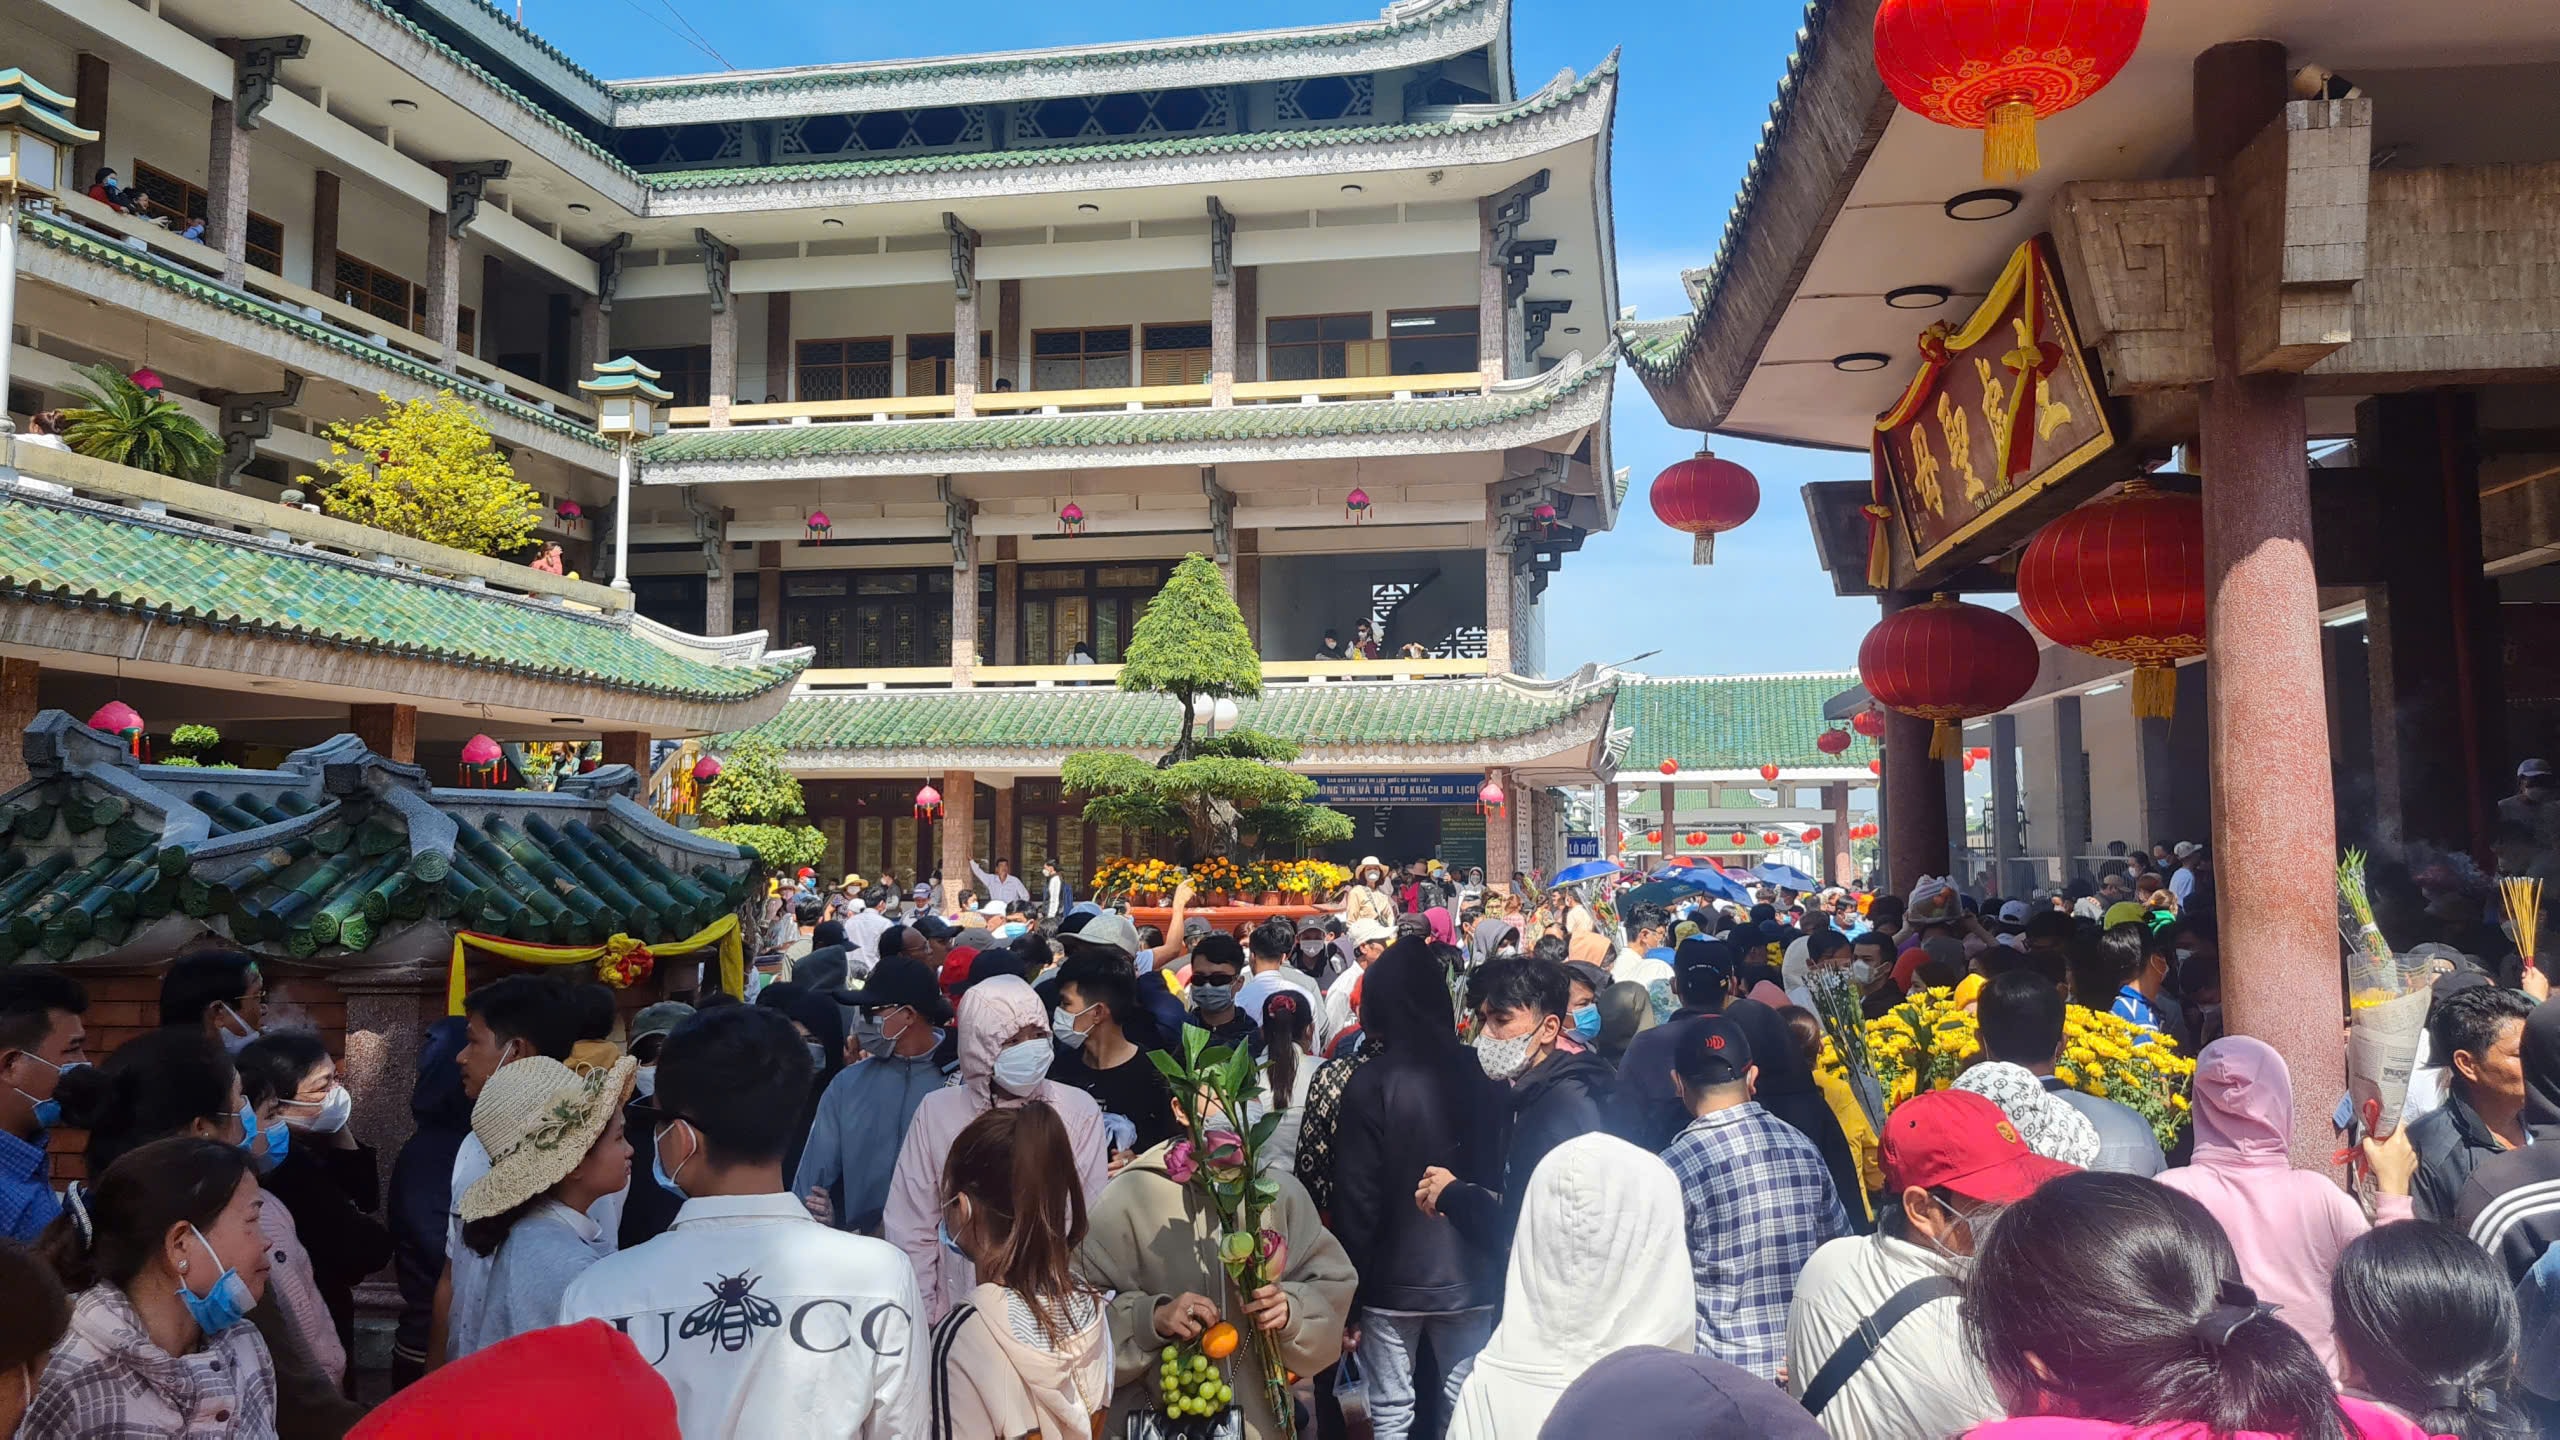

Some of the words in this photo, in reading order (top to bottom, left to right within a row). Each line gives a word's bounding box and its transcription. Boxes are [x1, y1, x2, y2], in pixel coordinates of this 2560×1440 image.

[1342, 785, 1356, 795] TIN
[1359, 783, 1371, 795] VÀ
[1374, 782, 1386, 795] HỖ
[1390, 784, 1407, 796] TRỢ
[1409, 783, 1439, 795] KHÁCH
[1441, 785, 1454, 795] DU
[1456, 785, 1476, 796] LỊCH
[1569, 841, 1579, 855] LÒ
[1580, 840, 1597, 855] ĐỐT
